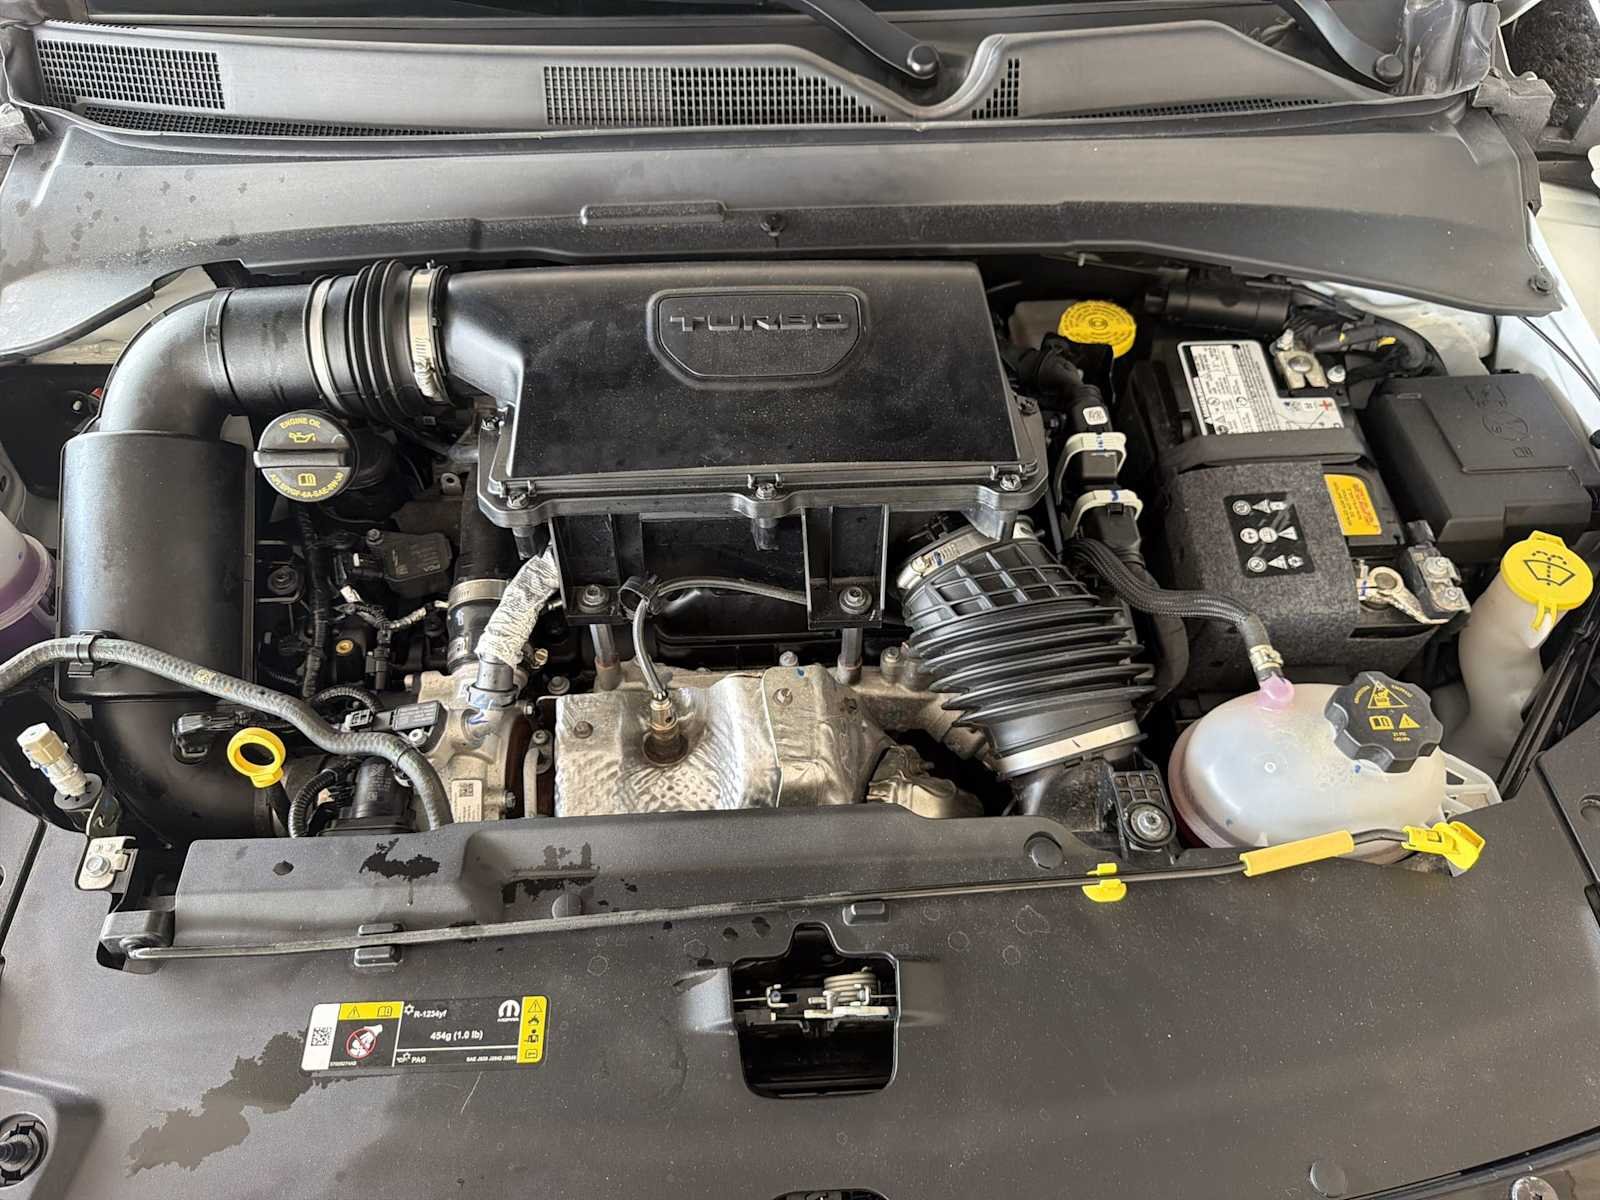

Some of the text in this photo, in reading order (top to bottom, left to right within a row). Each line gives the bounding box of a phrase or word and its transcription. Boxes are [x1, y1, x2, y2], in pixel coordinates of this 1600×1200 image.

[669, 312, 849, 332] TURBO
[279, 417, 321, 429] ENGINE OIL
[413, 1009, 448, 1019] R-1234yf
[430, 1029, 484, 1042] 454g (1.0 lb)
